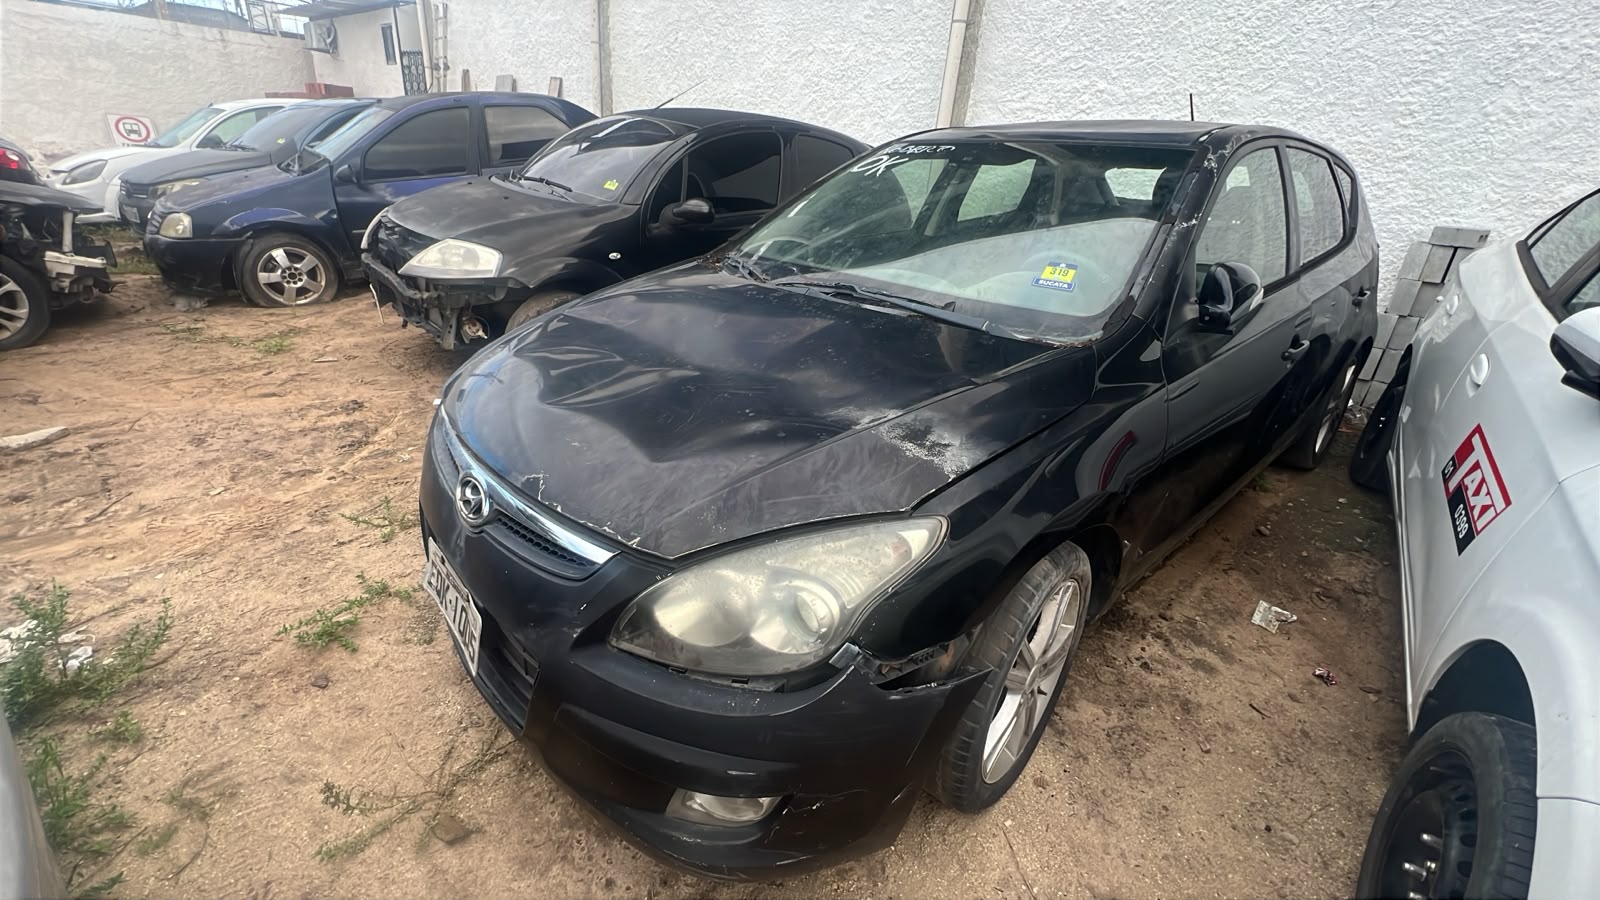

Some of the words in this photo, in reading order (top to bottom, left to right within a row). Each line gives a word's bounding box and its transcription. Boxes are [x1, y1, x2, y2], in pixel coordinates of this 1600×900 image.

[849, 155, 909, 177] OK
[1049, 267, 1070, 278] 319
[1038, 279, 1069, 289] SUCATA
[1447, 432, 1506, 531] TAXI
[1454, 503, 1469, 539] 0399
